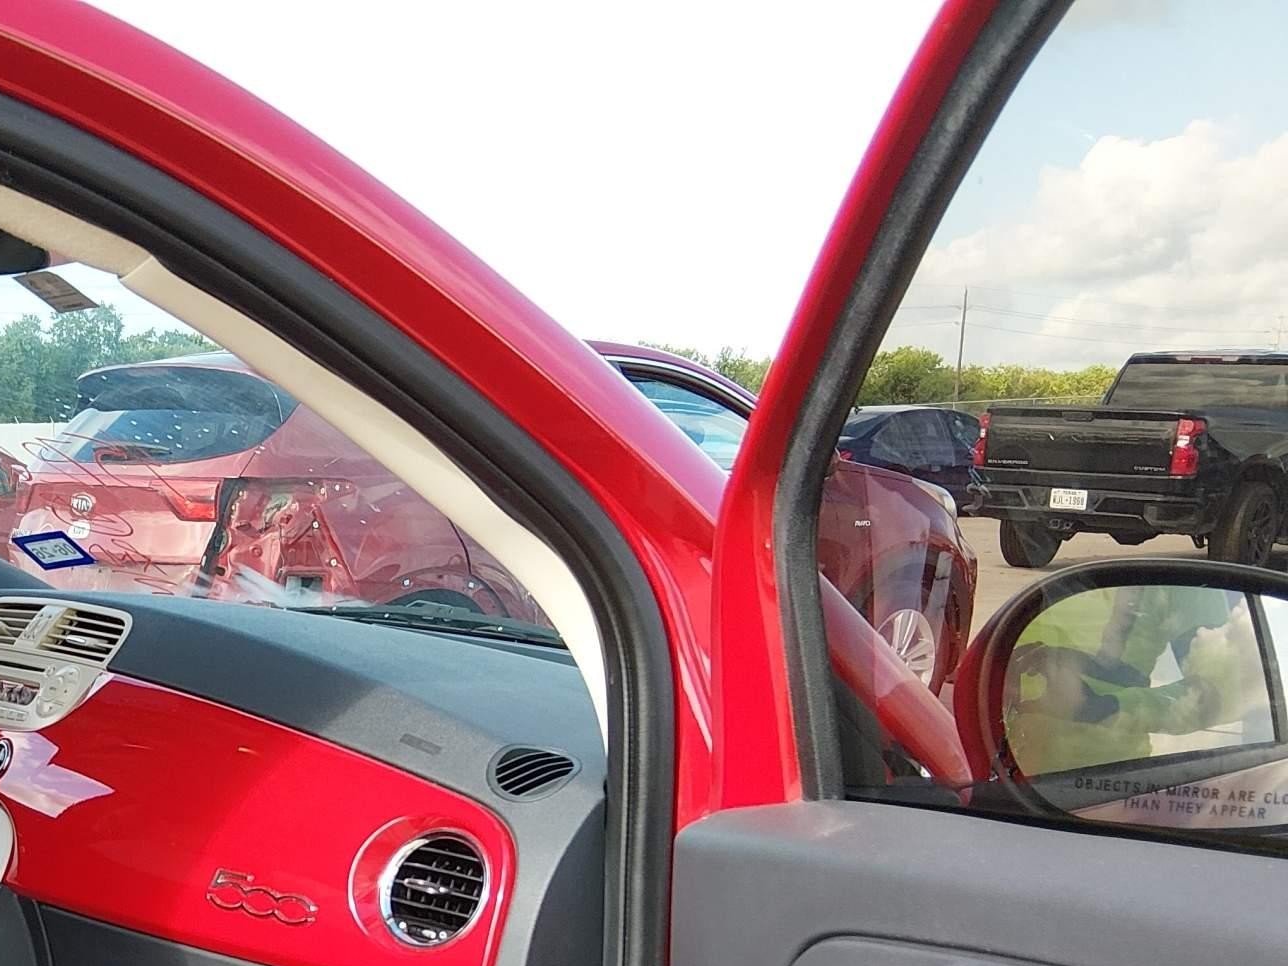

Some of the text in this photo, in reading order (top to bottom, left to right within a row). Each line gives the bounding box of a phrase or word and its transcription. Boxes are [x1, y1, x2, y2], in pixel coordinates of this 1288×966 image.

[1074, 778, 1141, 793] OBJECTS
[1167, 785, 1220, 799] MIRROR
[1228, 790, 1256, 802] ARE
[1123, 799, 1266, 819] THAN THEY APPEAR
[207, 868, 319, 925] 500
